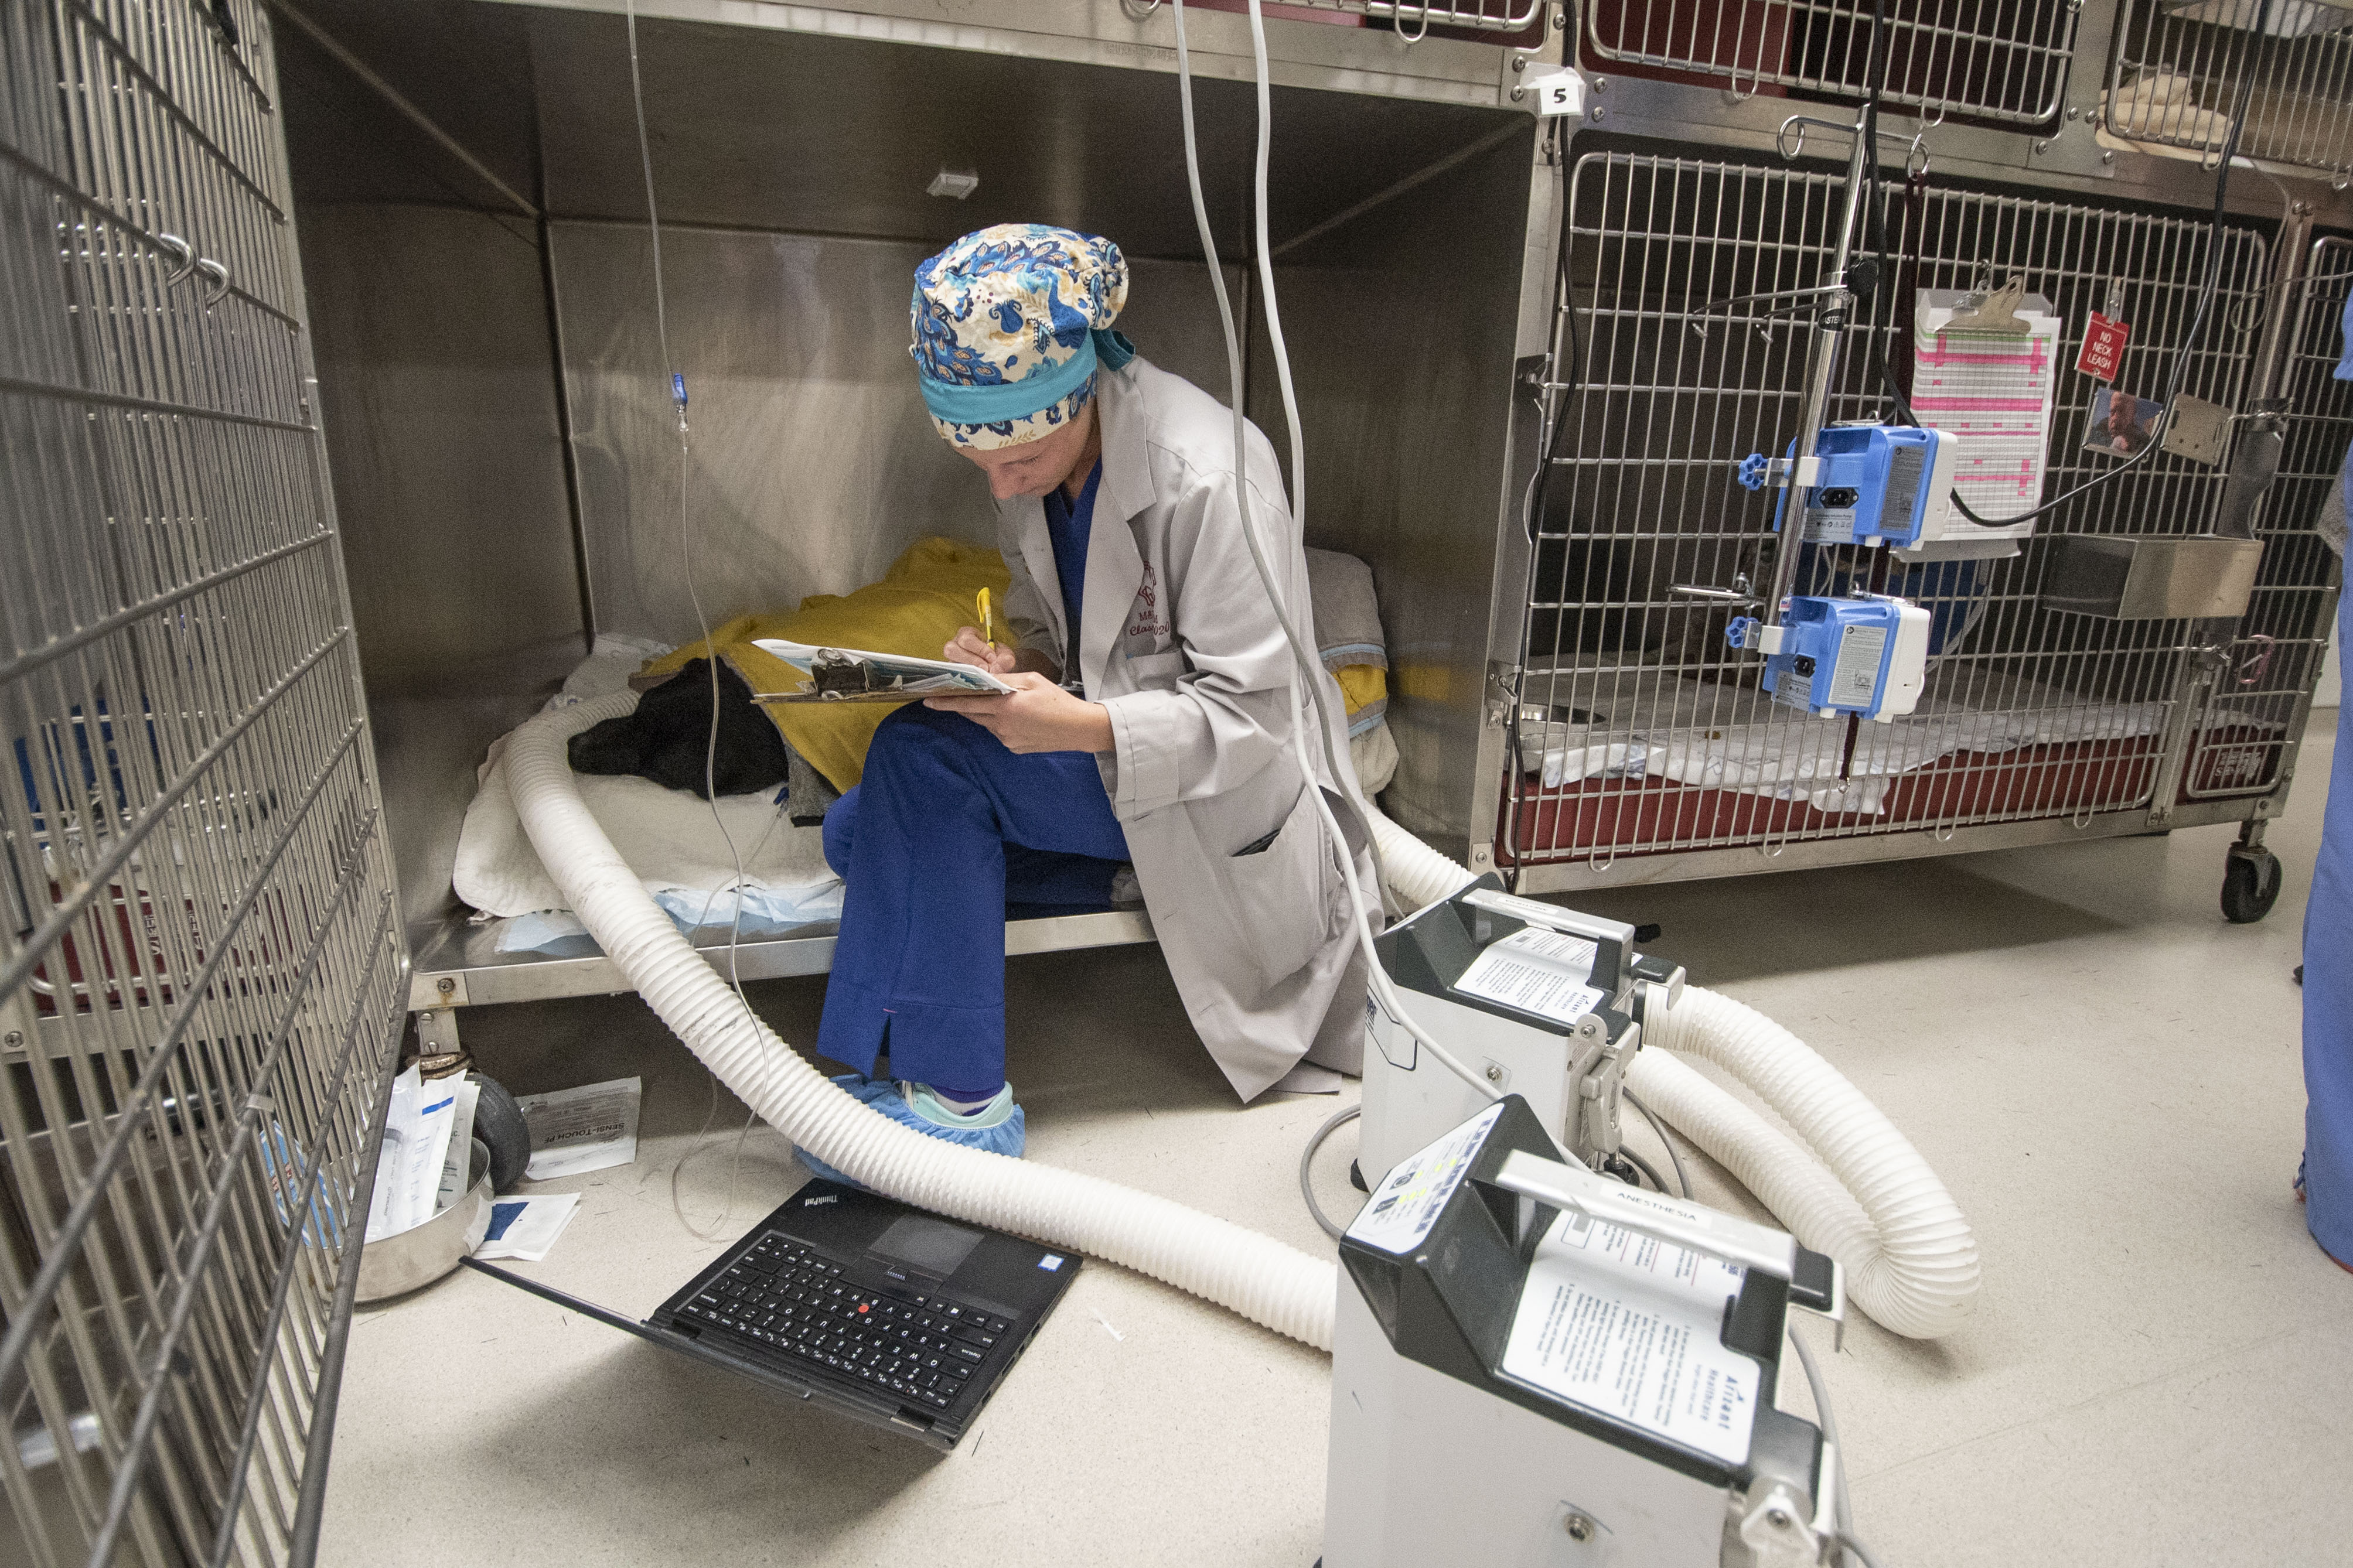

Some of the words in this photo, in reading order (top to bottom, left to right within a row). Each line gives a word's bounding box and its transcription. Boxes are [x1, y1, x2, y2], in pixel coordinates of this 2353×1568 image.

[1553, 88, 1567, 104] 5
[2099, 331, 2112, 344] NO
[2092, 341, 2113, 357] NECK
[2087, 353, 2112, 370] LEASH
[558, 1122, 625, 1140] SENSI-TOUCH
[804, 1195, 838, 1207] ThinkPad
[1617, 1192, 1697, 1222] ANESTHESIA
[1700, 1368, 1719, 1420] Healthcare
[1718, 1375, 1738, 1429] Arizant
